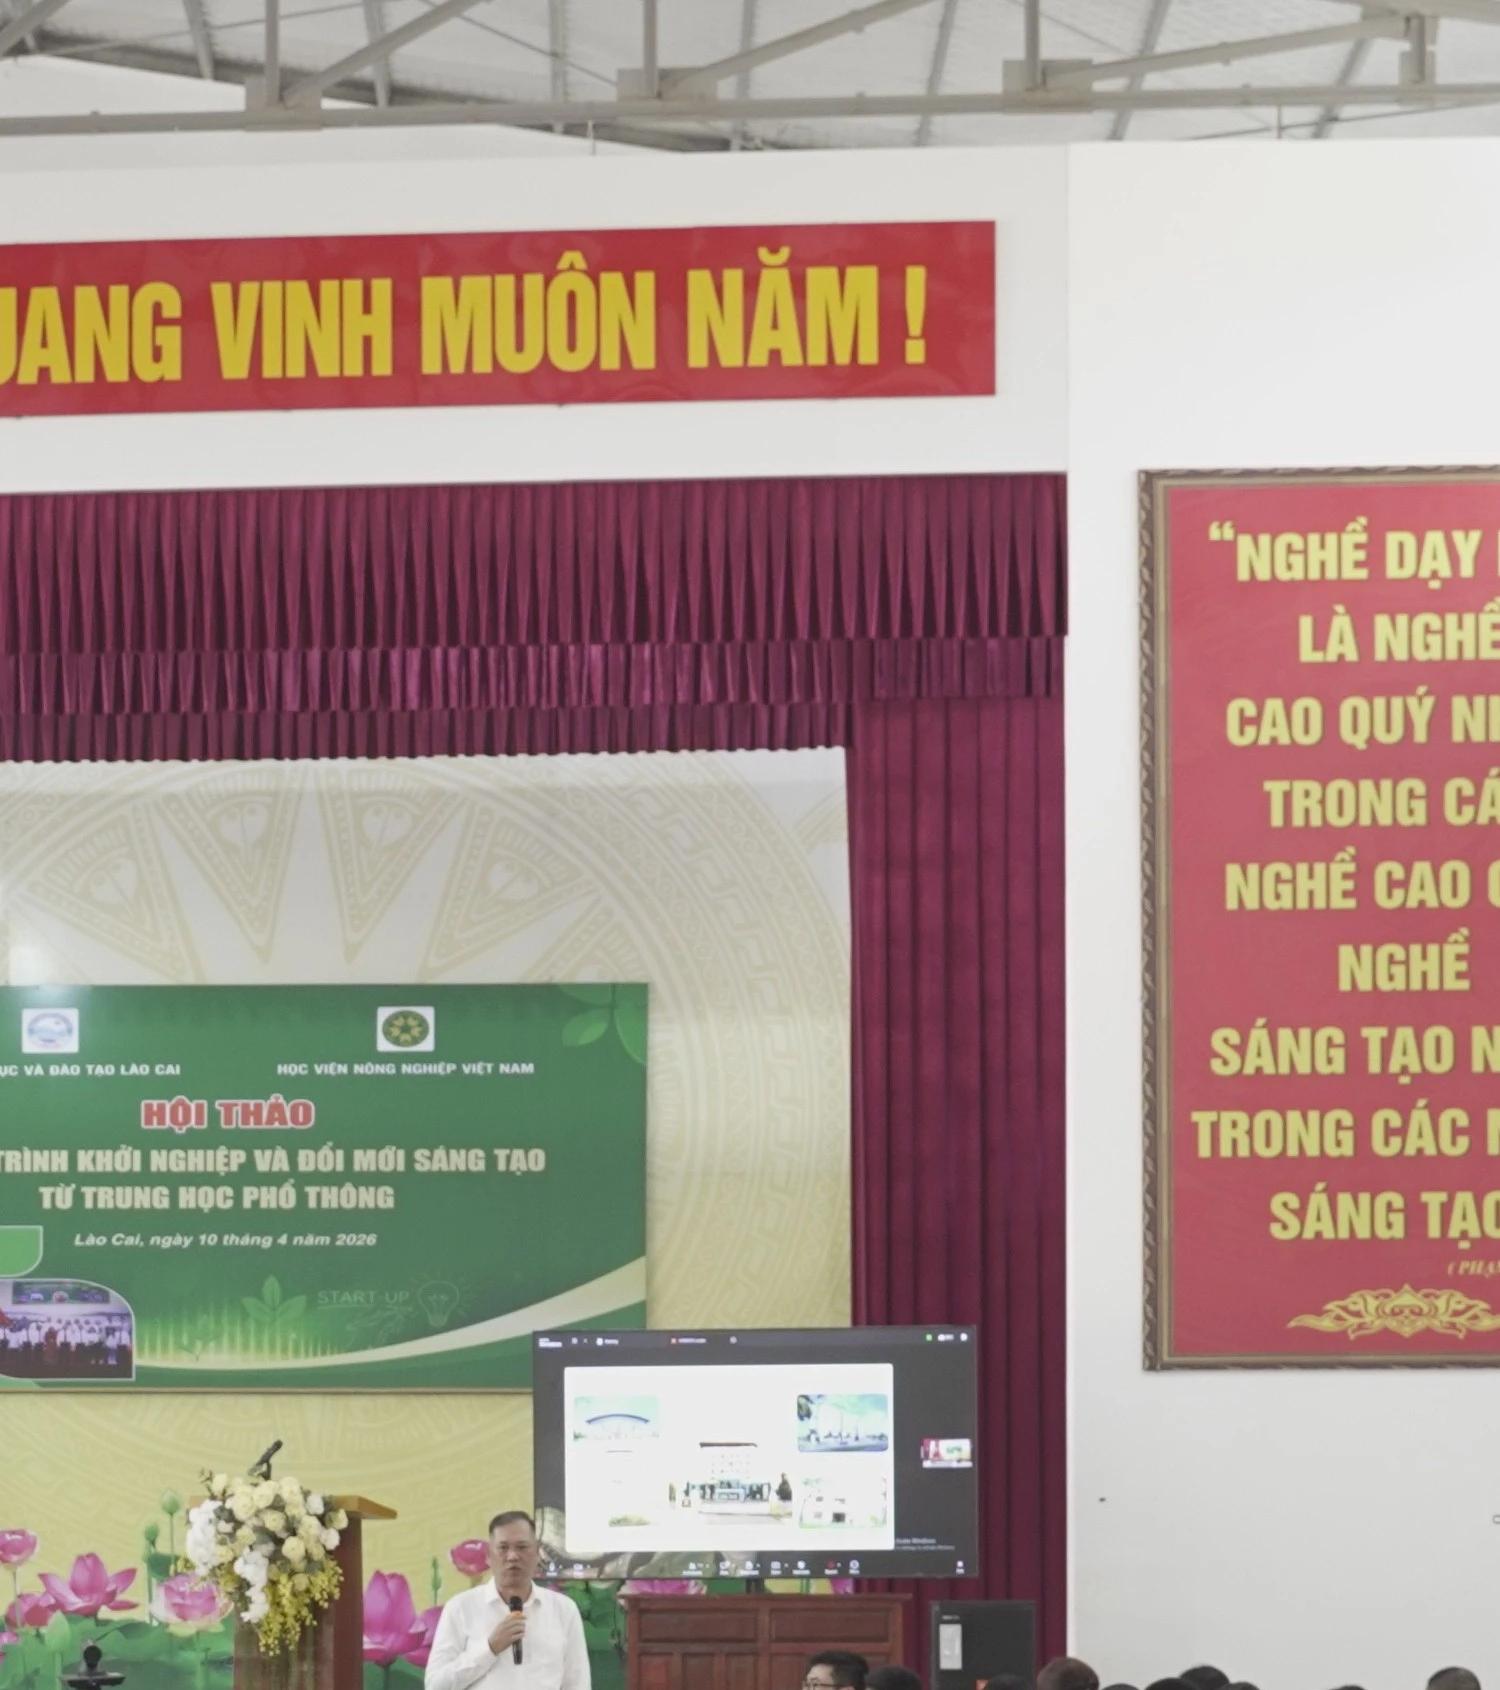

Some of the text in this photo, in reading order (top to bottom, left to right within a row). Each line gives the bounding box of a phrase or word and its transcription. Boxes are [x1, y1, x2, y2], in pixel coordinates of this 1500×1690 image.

[212, 278, 392, 379] VINH
[422, 252, 655, 374] MUÔN
[688, 247, 878, 367] NĂM
[906, 267, 925, 363] !
[1209, 516, 1370, 582] “NGHỀ
[1385, 529, 1484, 590] DẠY
[1298, 604, 1360, 663] LÀ
[1226, 696, 1324, 747] CAO
[1339, 684, 1437, 751] QUÝ
[1262, 777, 1428, 828] TRONG
[1225, 845, 1358, 911] NGHỀ
[1373, 859, 1471, 910] CAO
[1338, 927, 1471, 992] NGHỀ
[23, 1062, 45, 1076] VÀ
[154, 1062, 181, 1076] CAI
[276, 1062, 309, 1078] HỌC
[462, 1061, 494, 1077] VIỆT
[499, 1062, 535, 1075] NAM
[1210, 1017, 1346, 1077] SÁNG
[1360, 1025, 1454, 1085] TẠO
[141, 1094, 316, 1133] HỘI THẢO
[1191, 1108, 1354, 1159] TRONG
[1371, 1099, 1470, 1157] CÁC
[77, 1144, 142, 1173] KHỞI
[150, 1148, 247, 1177] NGHIỆP
[253, 1145, 290, 1172] VÀ
[298, 1141, 344, 1172] ĐỔI
[353, 1144, 406, 1172] MỚI
[414, 1145, 486, 1172] SÁNG
[494, 1148, 546, 1176] TẠO
[39, 1178, 396, 1212] TỪ TRUNG HỌC PHỔ THÔNG
[1269, 1182, 1405, 1240] SÁNG
[74, 1232, 378, 1249] Lào Cai, ngày 10 tháng 4 năm 2026
